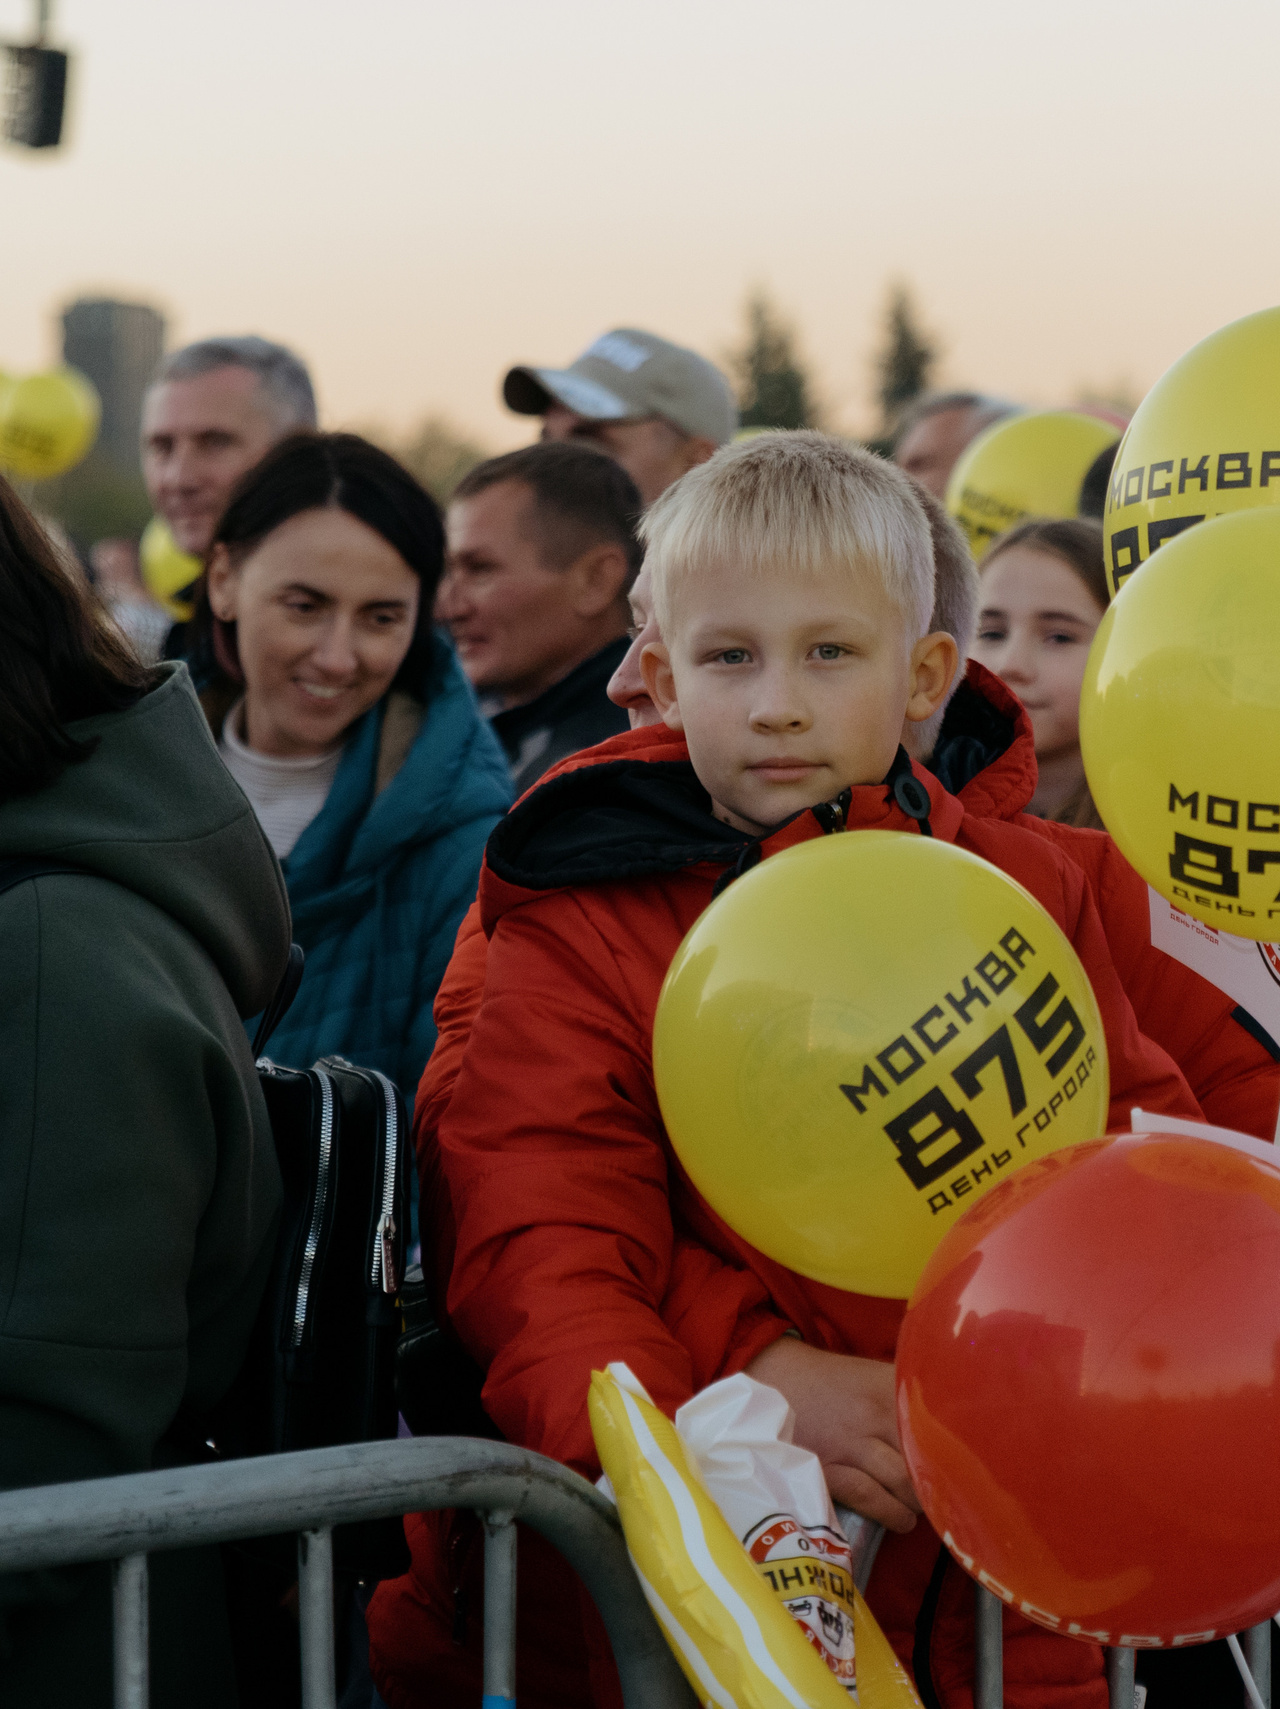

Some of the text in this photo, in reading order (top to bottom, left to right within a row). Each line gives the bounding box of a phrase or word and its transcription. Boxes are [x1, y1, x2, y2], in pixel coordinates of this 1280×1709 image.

[1170, 913, 1190, 929] ДЕНЬ
[1191, 924, 1219, 946] ГОРОДА
[1172, 885, 1256, 917] ДЕНЬ
[838, 926, 1037, 1115] МОСКВА
[882, 971, 1087, 1192] 875
[927, 1045, 1098, 1216] ДЕНЬ ГОРОДА
